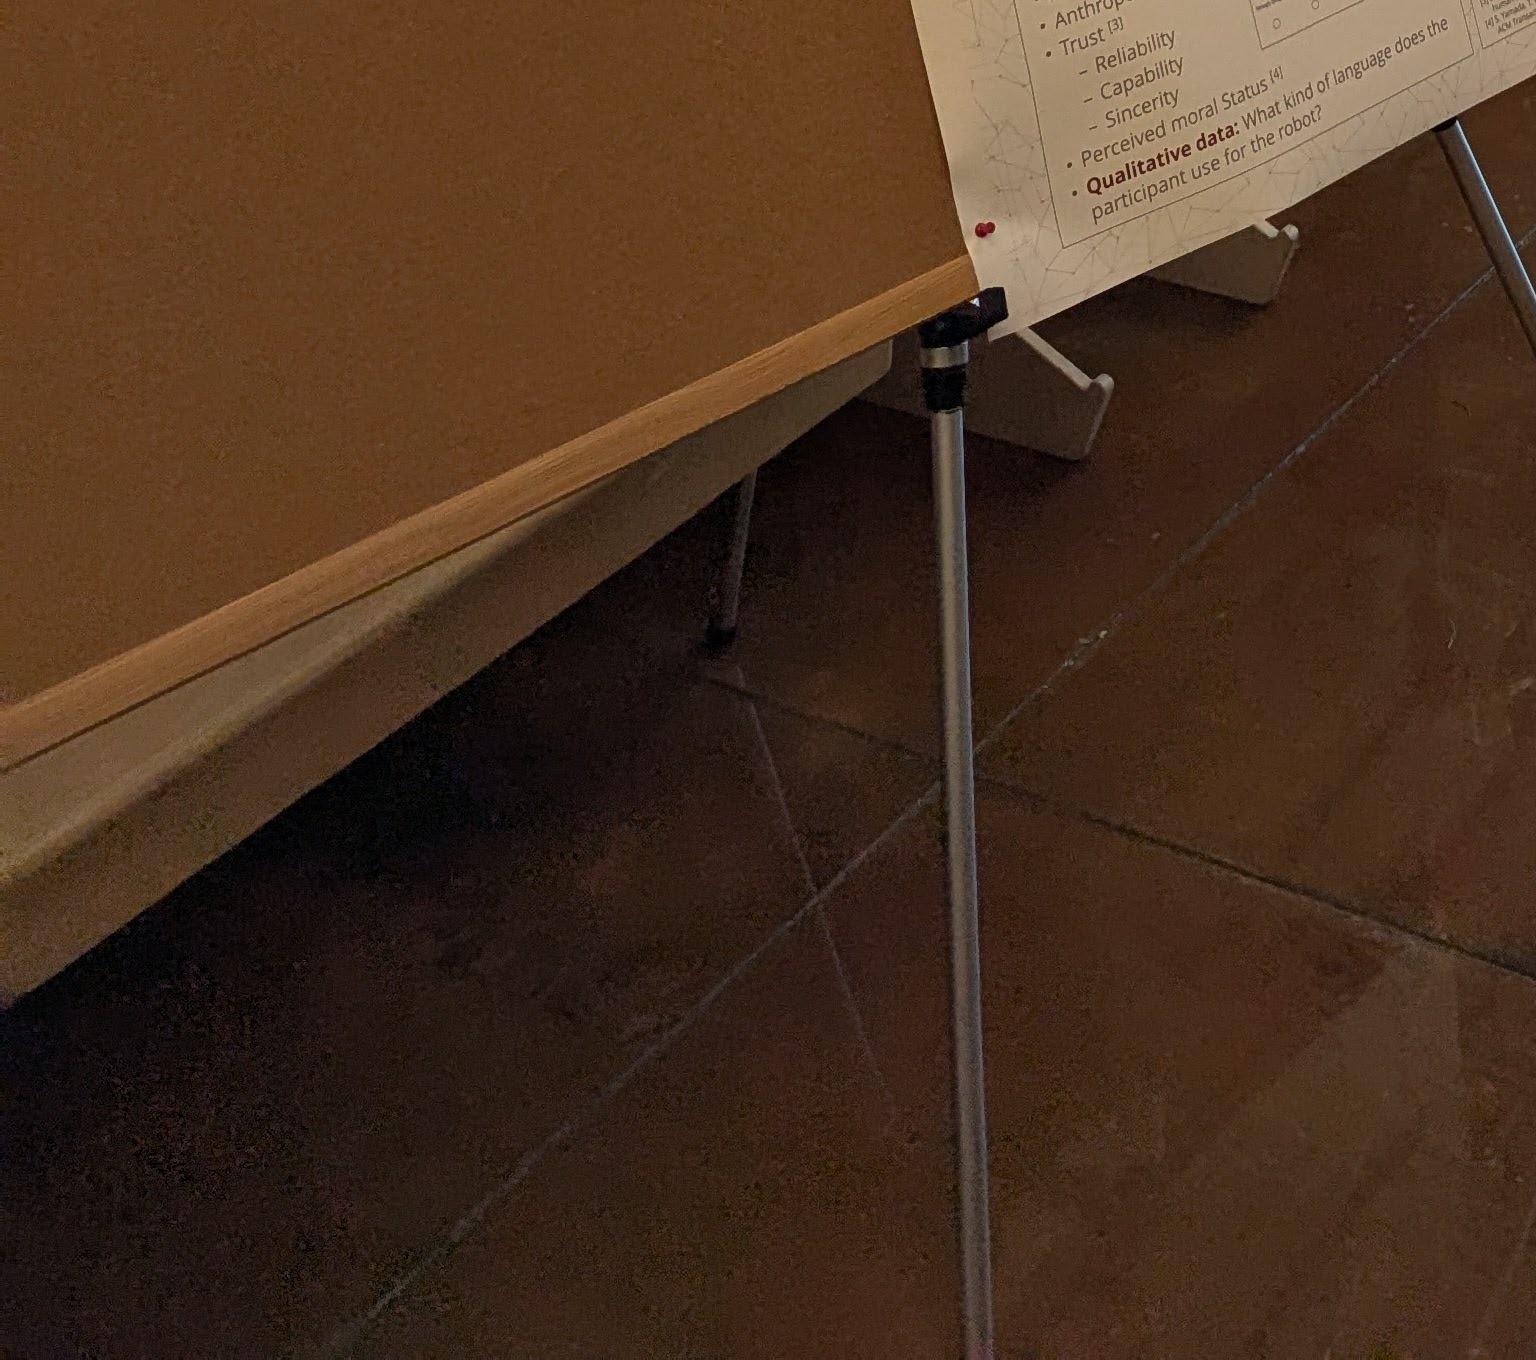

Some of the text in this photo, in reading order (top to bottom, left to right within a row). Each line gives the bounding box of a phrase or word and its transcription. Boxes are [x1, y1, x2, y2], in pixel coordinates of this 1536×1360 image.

[1058, 27, 1105, 56] Trust
[1095, 30, 1175, 73] Reliability
[1100, 56, 1183, 100] Capability
[1105, 88, 1179, 128] Sincerity
